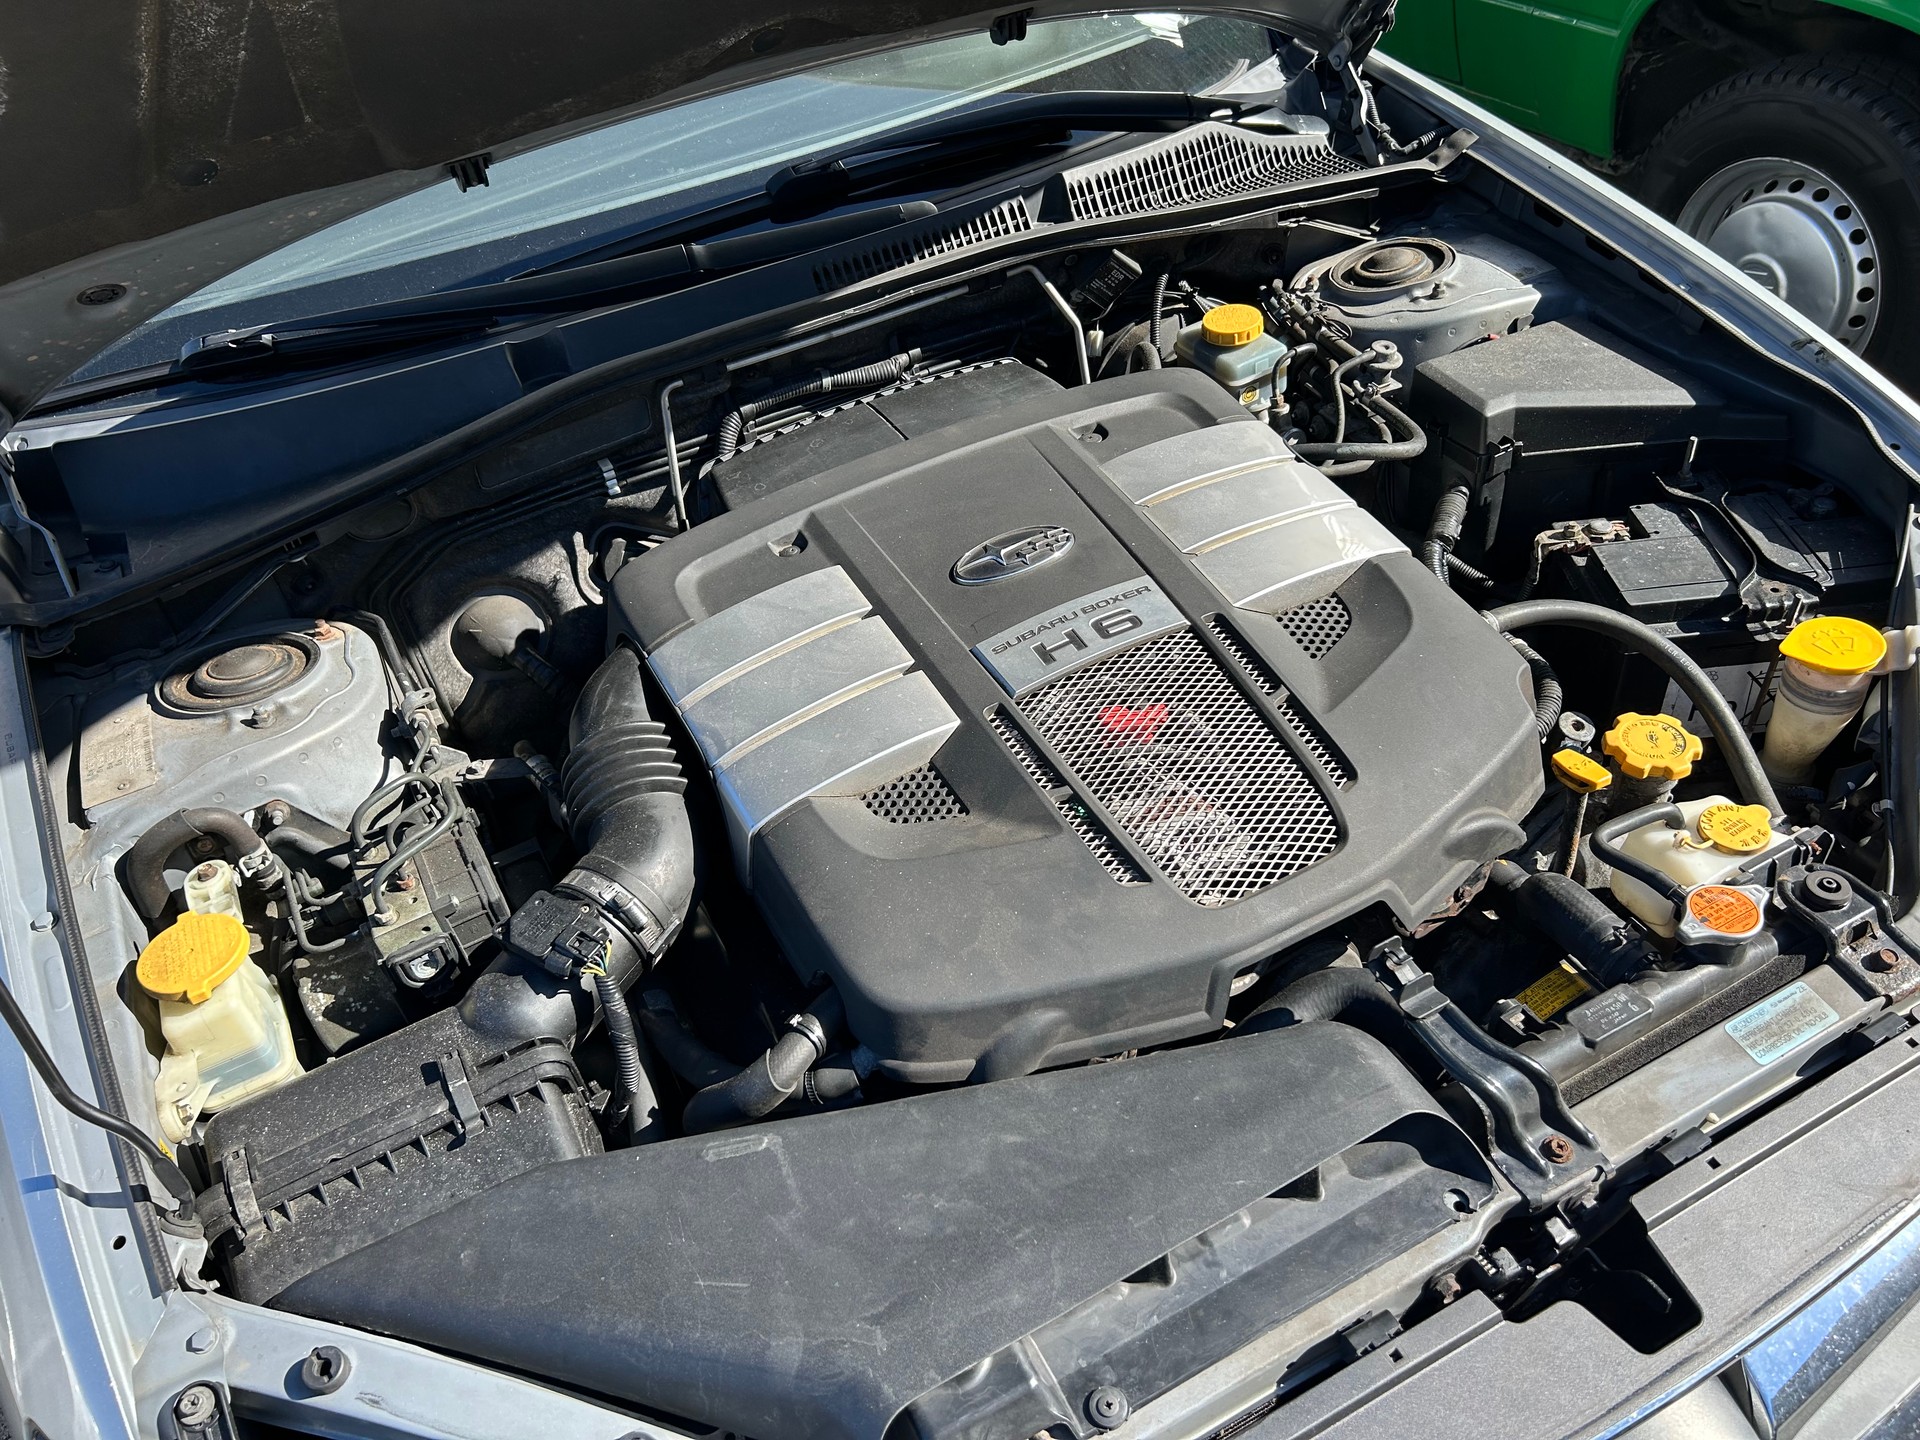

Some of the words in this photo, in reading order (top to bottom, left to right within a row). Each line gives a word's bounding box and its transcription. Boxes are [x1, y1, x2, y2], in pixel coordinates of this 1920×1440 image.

[992, 612, 1079, 655] SUBARU
[1081, 585, 1152, 614] BOXER
[1627, 1002, 1640, 1012] 6
[1739, 1018, 1775, 1042] REFRIGERANT
[1755, 1032, 1794, 1058] COMPRESSOR
